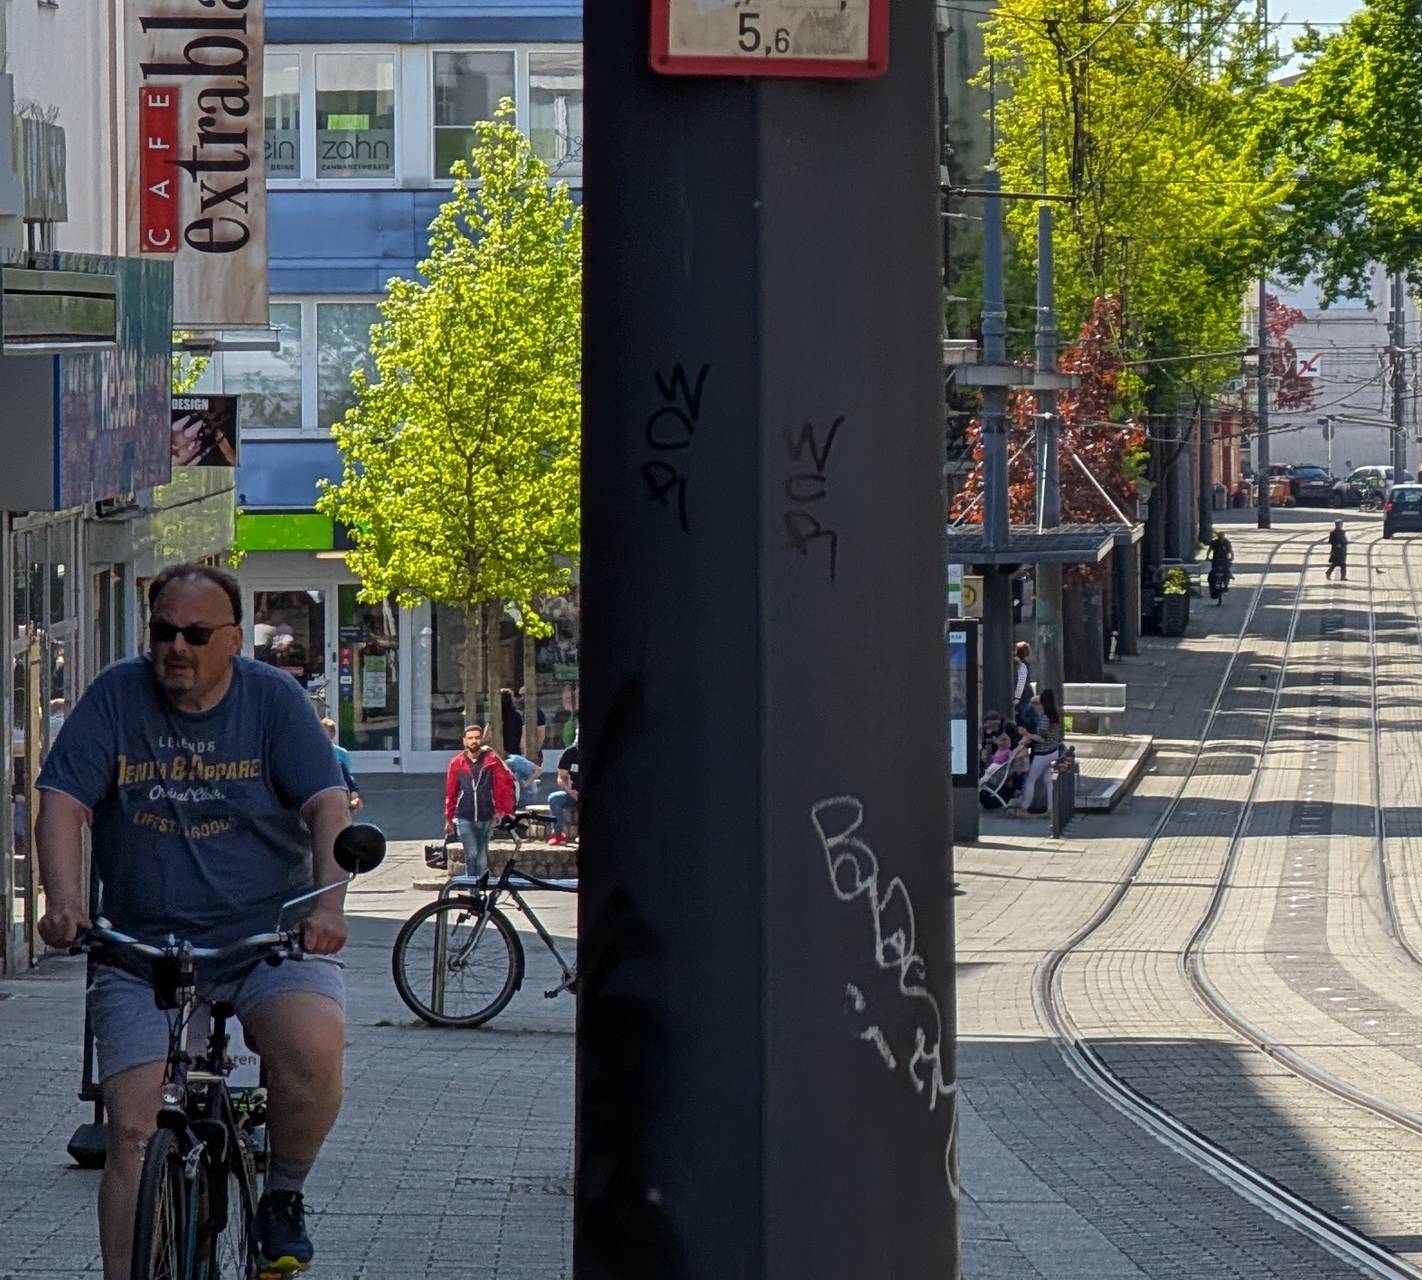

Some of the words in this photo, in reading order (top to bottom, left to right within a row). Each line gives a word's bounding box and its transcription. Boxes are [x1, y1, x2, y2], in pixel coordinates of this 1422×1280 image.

[738, 13, 791, 56] 5,6
[140, 0, 251, 253] extrabl
[321, 133, 390, 160] zahn
[148, 94, 171, 246] CAFE
[172, 398, 209, 411] DESIGN
